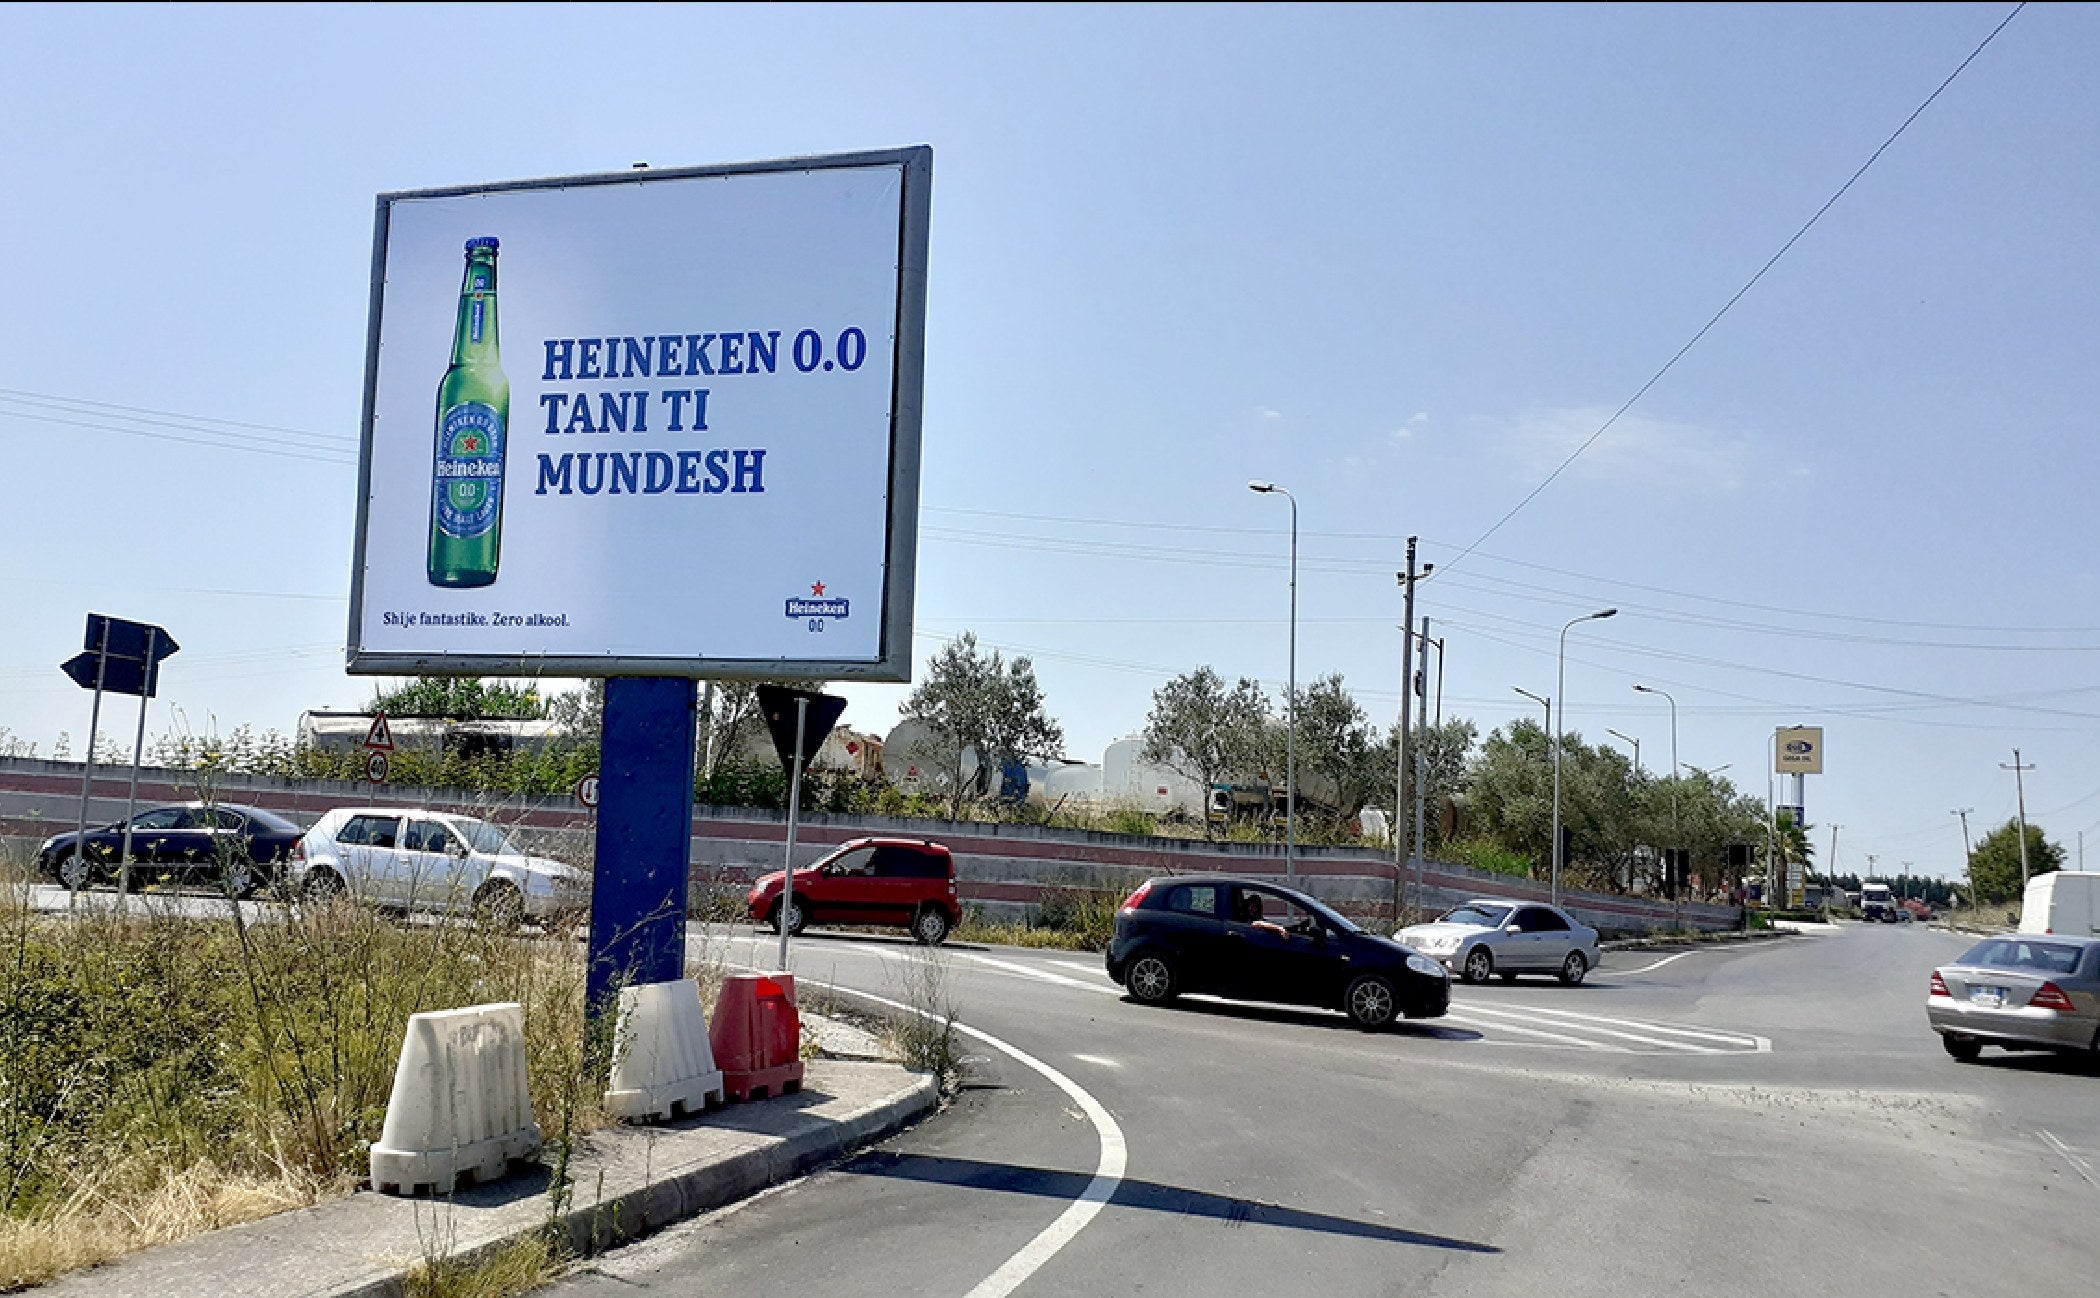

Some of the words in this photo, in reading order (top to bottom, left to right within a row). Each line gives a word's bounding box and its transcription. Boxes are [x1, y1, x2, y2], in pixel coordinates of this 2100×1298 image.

[542, 331, 781, 379] HEINEKEN
[793, 327, 867, 372] 0.0
[539, 391, 650, 434] TANI
[661, 389, 710, 432] TI
[535, 449, 767, 495] MUNDESH
[383, 611, 417, 628] Shije
[419, 611, 489, 626] fantastike.
[492, 611, 524, 626] Zero
[525, 612, 571, 627] alkool.
[789, 601, 846, 614] Heineken
